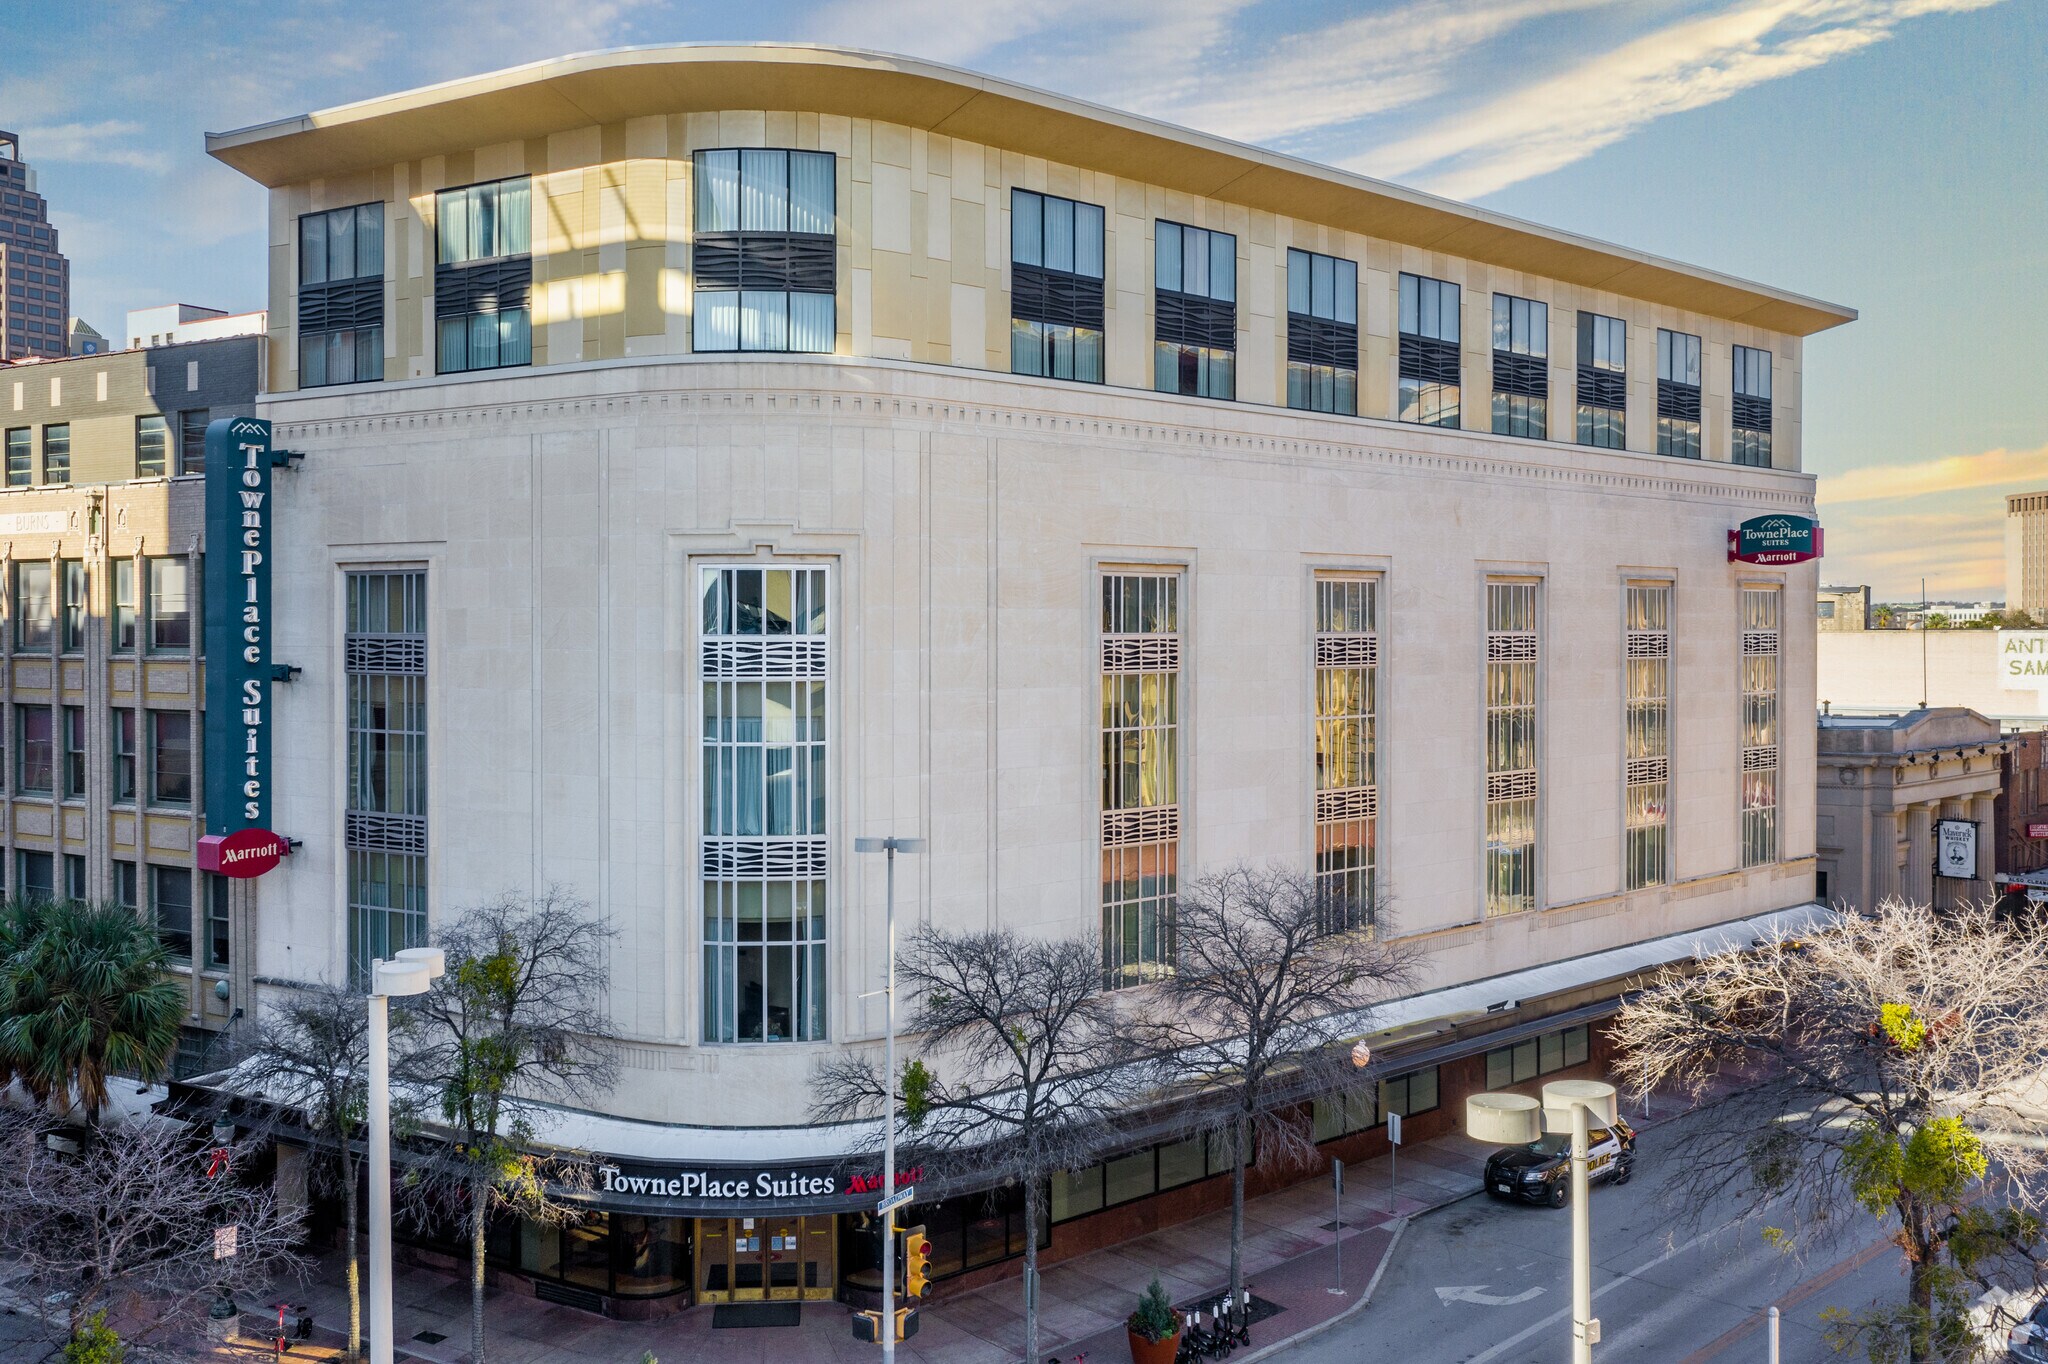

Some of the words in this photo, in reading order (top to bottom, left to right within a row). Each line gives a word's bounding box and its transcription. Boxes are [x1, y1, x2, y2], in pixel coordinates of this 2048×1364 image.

[16, 515, 49, 531] BURNS
[1743, 528, 1809, 540] TownePlace
[238, 442, 265, 663] TownePlace
[1755, 552, 1797, 563] Marriott
[242, 680, 262, 819] Suites
[1943, 827, 1972, 838] Maverick
[222, 843, 278, 864] Marriott
[598, 1166, 750, 1198] TownePlace
[756, 1171, 835, 1198] Suites
[844, 1165, 924, 1196] Mariott
